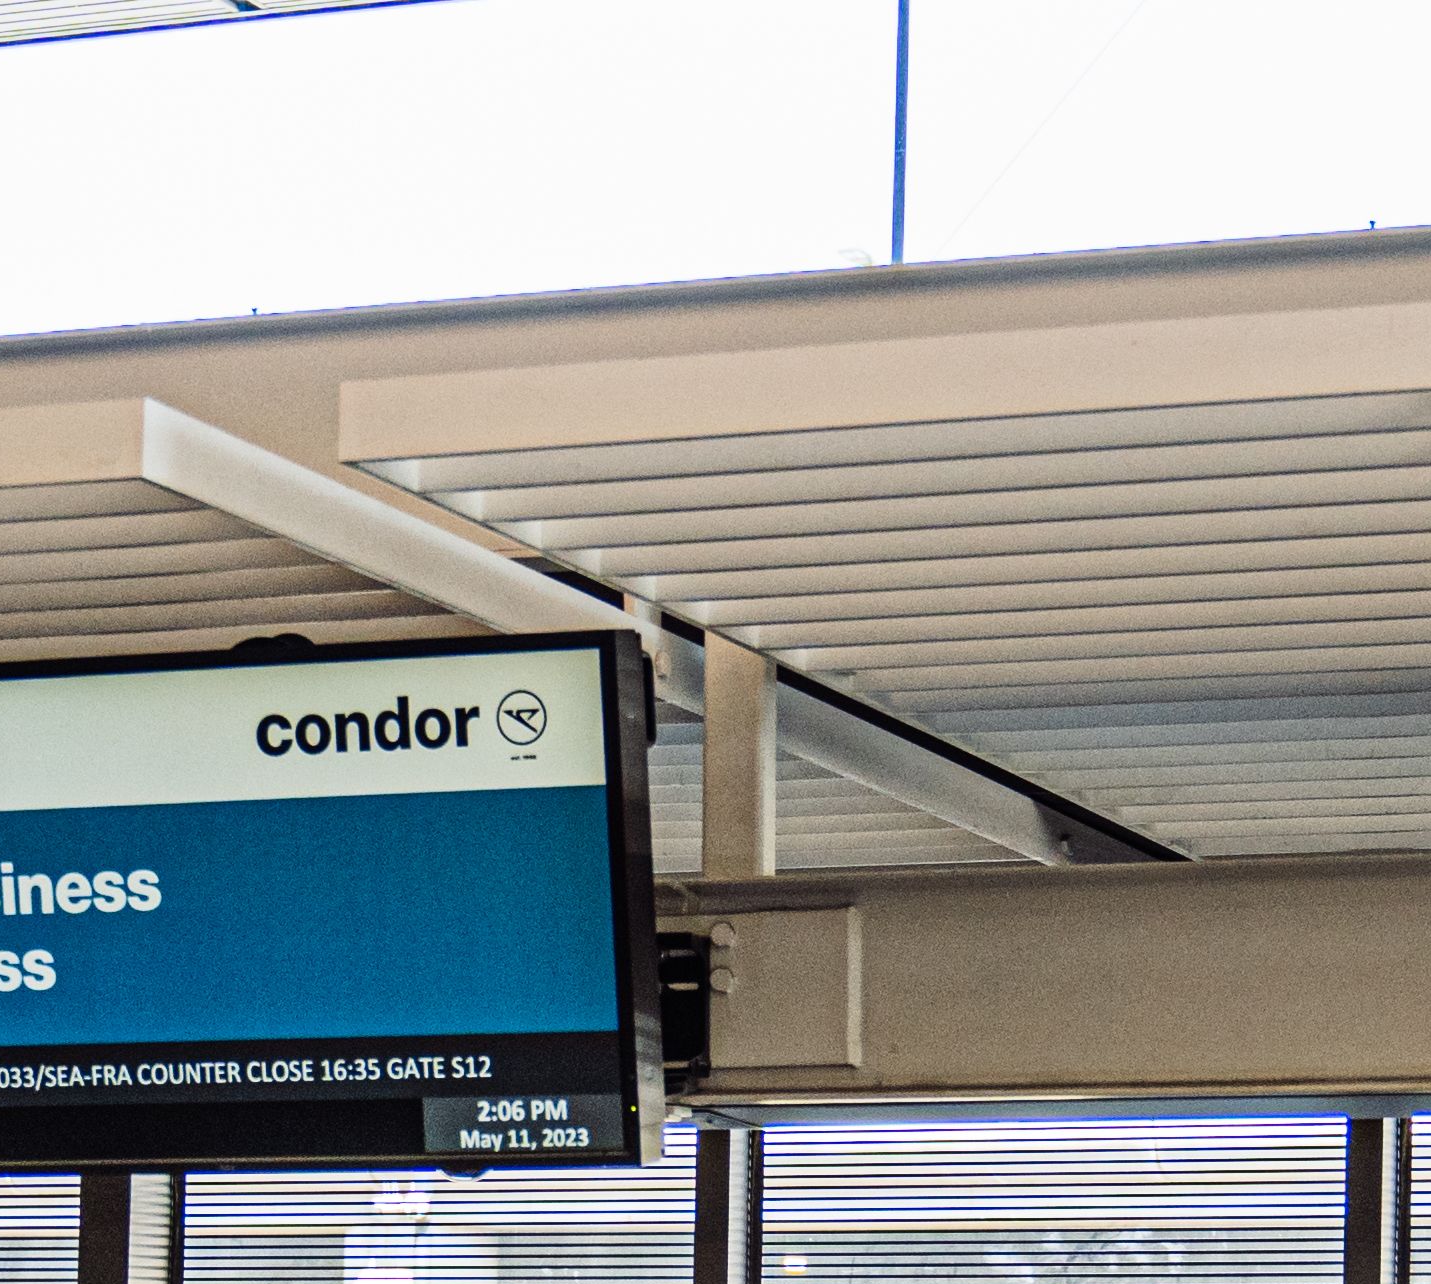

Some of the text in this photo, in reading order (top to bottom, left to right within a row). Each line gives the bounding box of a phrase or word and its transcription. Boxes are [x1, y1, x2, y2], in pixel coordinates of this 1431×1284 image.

[257, 696, 479, 756] condor
[137, 1062, 242, 1086] COUNTER
[246, 1060, 314, 1083] CLOSE
[321, 1058, 381, 1082] 16:35
[386, 1056, 446, 1081] GATE
[451, 1055, 492, 1079] S12
[476, 1098, 568, 1123] 2:06 PM
[459, 1127, 590, 1152] May 11, 2023
